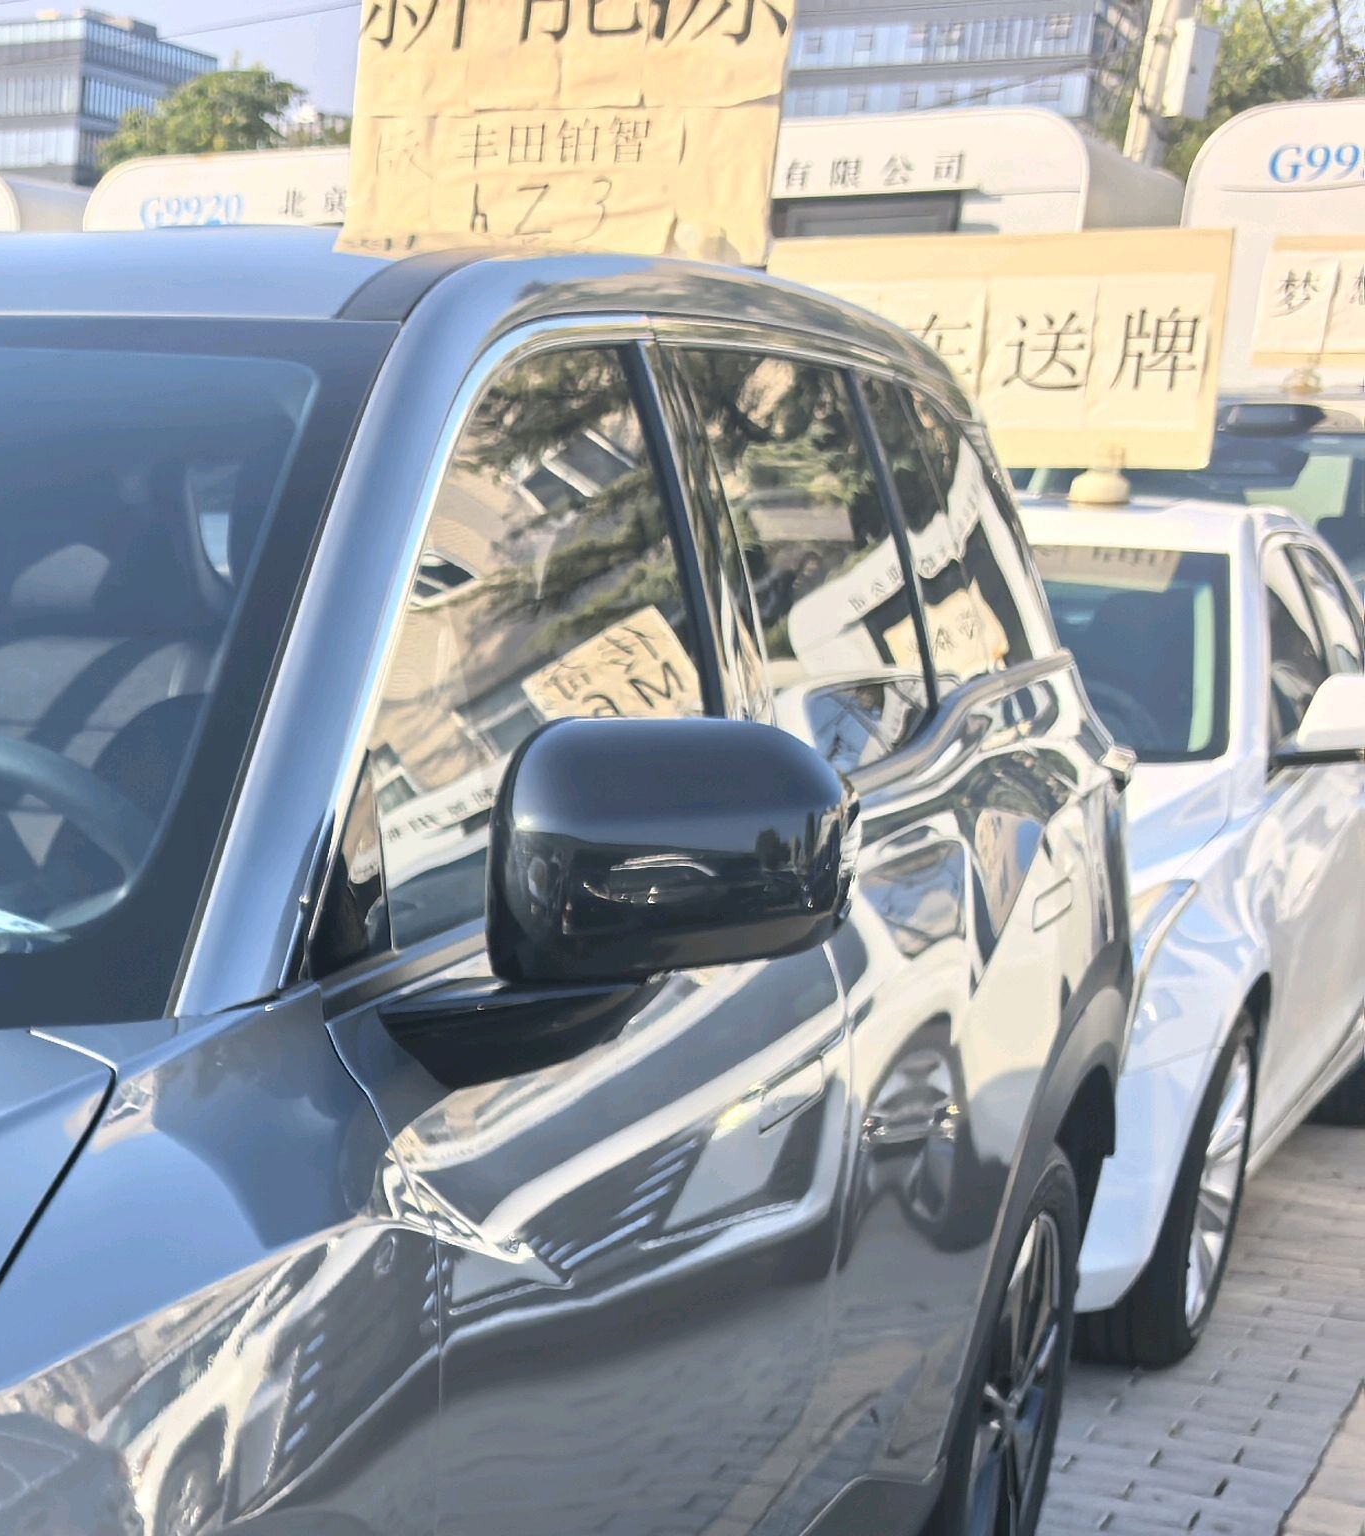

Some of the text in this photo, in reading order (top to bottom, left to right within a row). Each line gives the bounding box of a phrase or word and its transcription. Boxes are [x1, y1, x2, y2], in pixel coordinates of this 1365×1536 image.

[458, 115, 653, 168] 丰田铂智
[1268, 142, 1365, 184] G99
[140, 190, 246, 228] G9920
[786, 151, 965, 190] 有限公司
